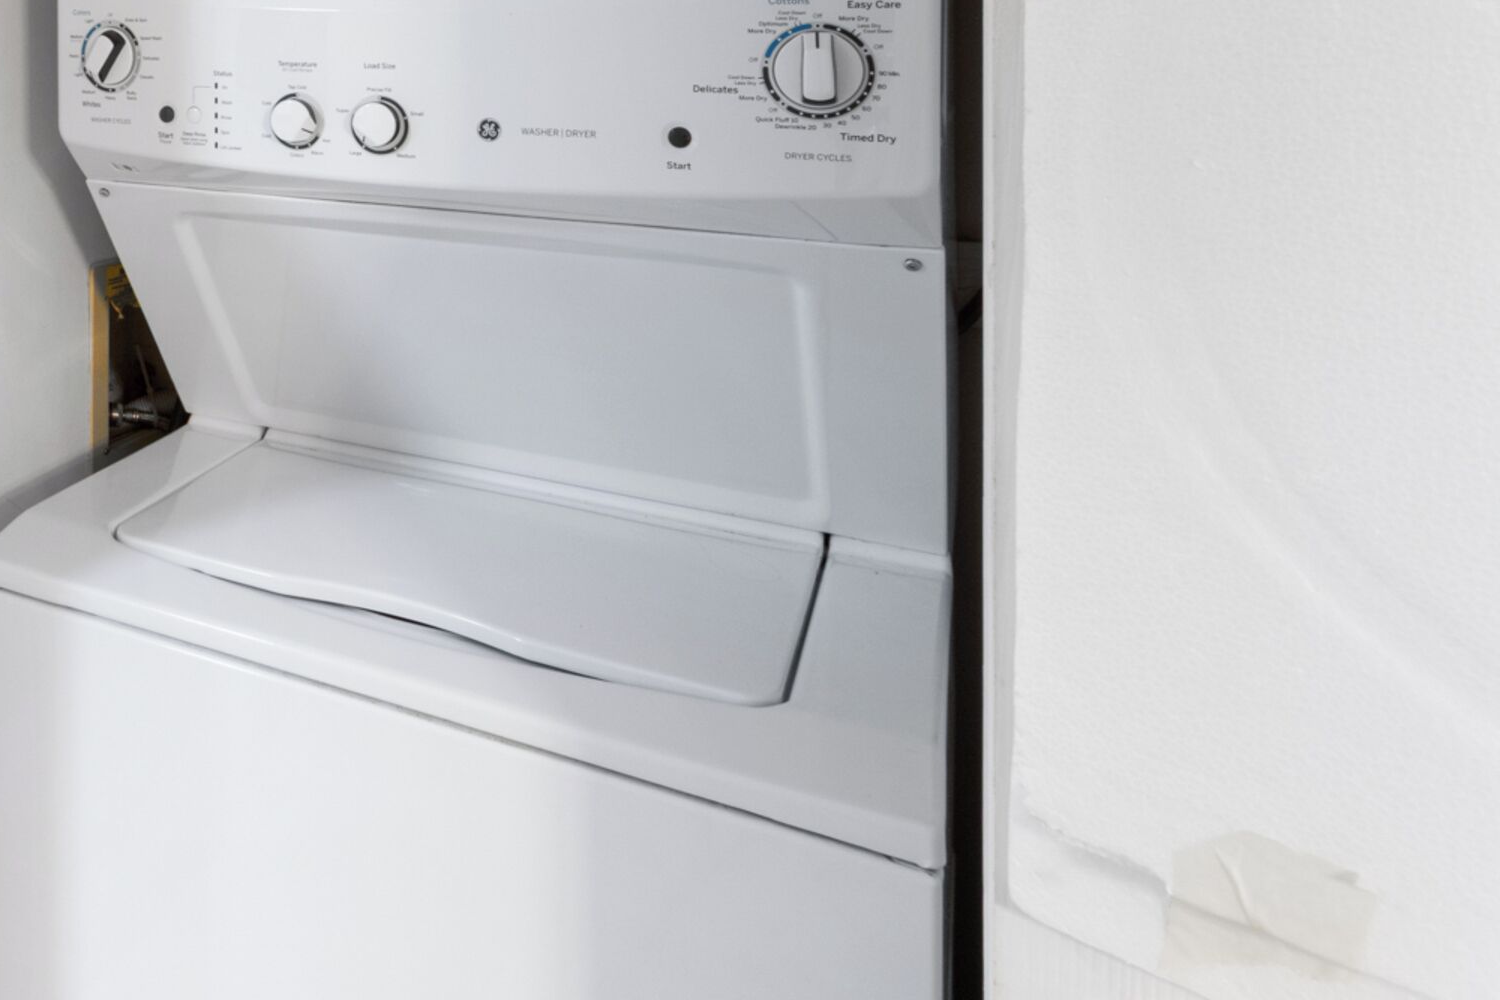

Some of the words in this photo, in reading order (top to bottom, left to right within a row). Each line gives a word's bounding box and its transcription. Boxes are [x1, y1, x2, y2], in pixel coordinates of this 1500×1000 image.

[846, 0, 873, 11] Easy
[875, 0, 902, 9] Care
[278, 60, 318, 68] Temperature
[382, 62, 396, 70] Size
[692, 84, 739, 94] Delicates
[157, 131, 174, 139] Start
[521, 126, 560, 137] WASHER
[565, 128, 597, 139] DRYER
[839, 132, 874, 143] Timed
[877, 133, 897, 145] Dry
[784, 151, 815, 161] DRYER
[816, 153, 853, 163] CYCLES
[666, 161, 692, 171] Start
